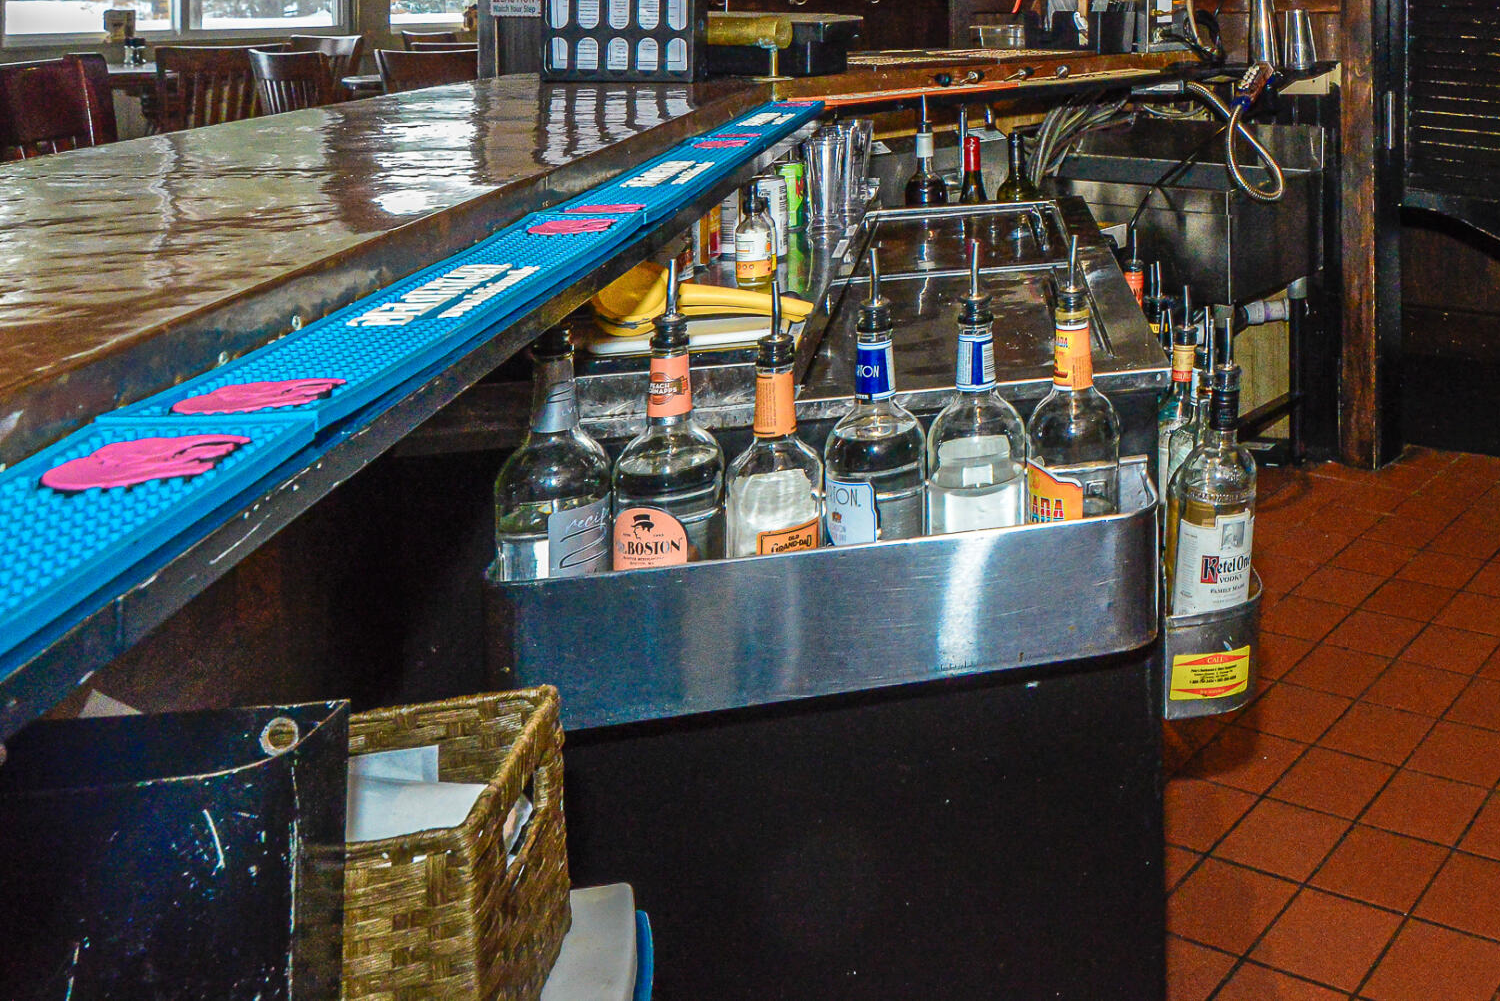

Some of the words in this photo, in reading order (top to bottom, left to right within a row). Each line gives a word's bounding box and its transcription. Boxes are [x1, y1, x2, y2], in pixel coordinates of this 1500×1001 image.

[510, 5, 523, 13] Your
[523, 5, 536, 14] Step
[627, 539, 681, 555] BOSTON
[1202, 556, 1236, 583] Ketel
[1207, 656, 1225, 664] CALL
